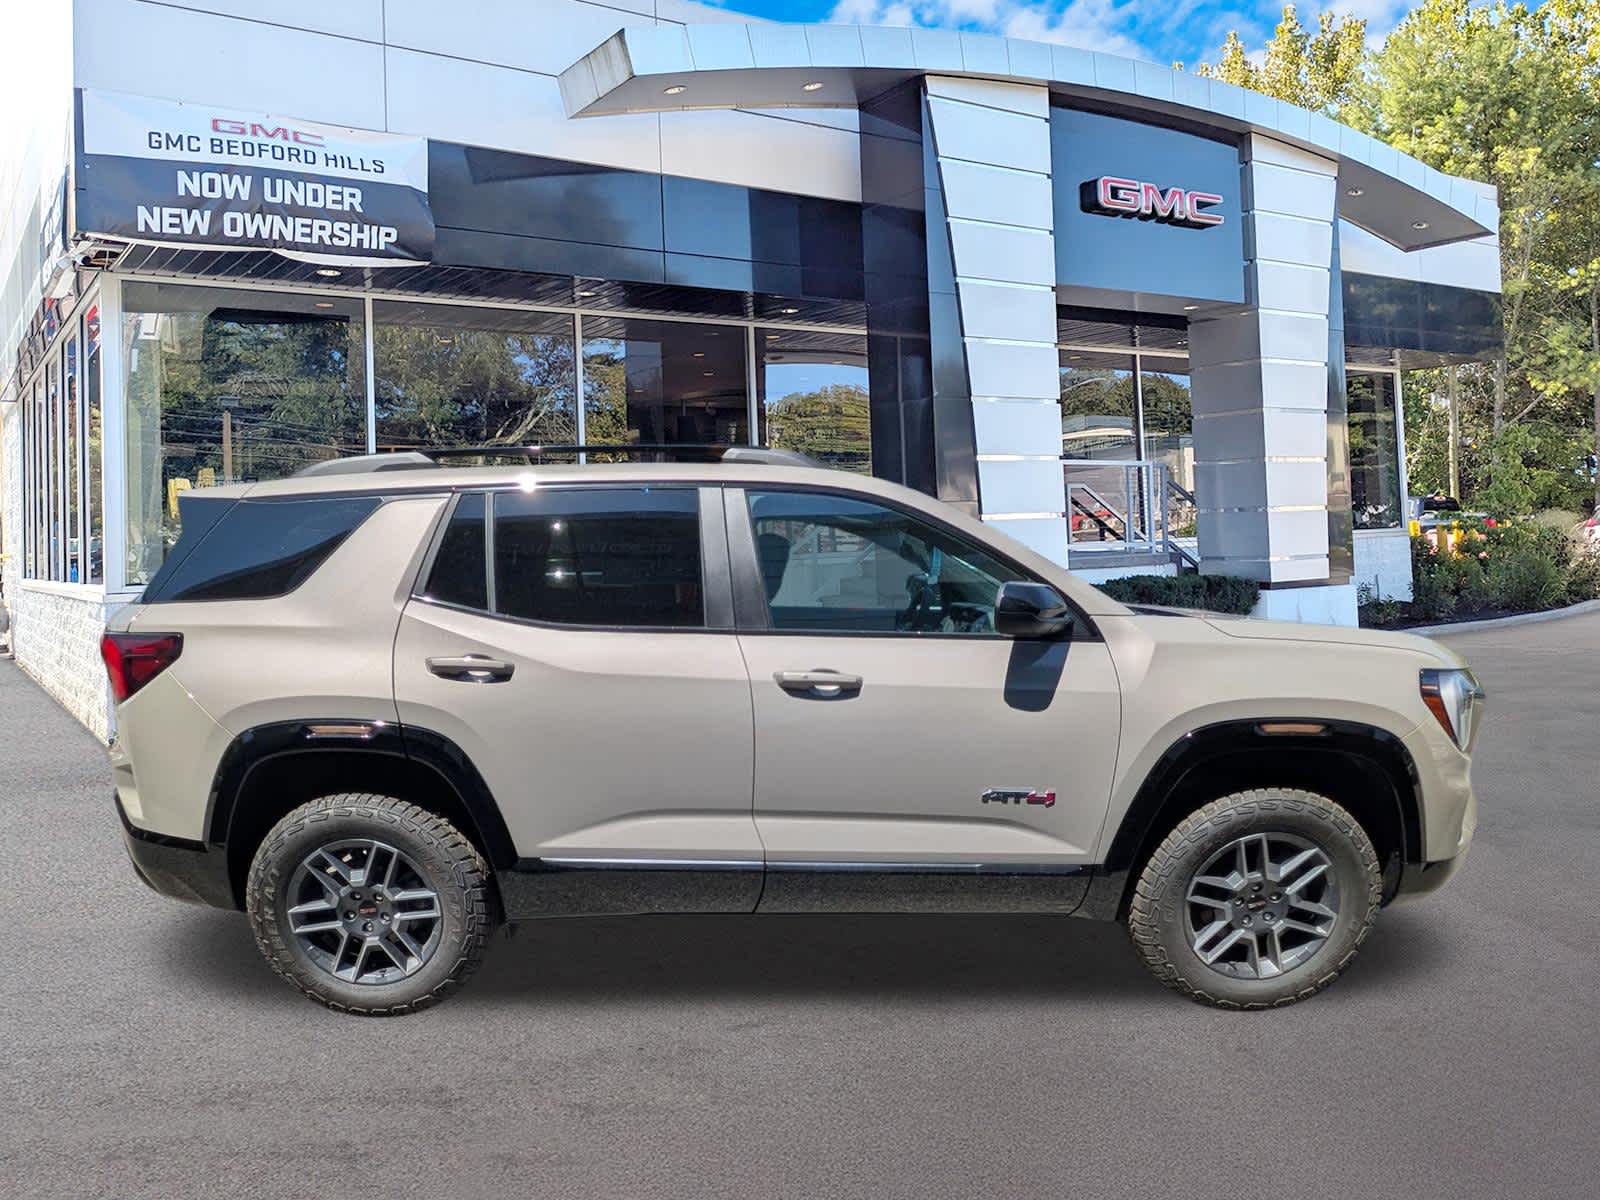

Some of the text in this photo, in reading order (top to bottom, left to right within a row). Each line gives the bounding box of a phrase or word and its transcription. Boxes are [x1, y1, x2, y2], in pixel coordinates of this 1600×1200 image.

[147, 131, 385, 174] GMC BEDFORD HILLS
[211, 118, 326, 149] GMC
[176, 170, 364, 213] NOW UNDER
[1097, 175, 1225, 225] GMC
[136, 206, 398, 250] NEW OWNERSHIP
